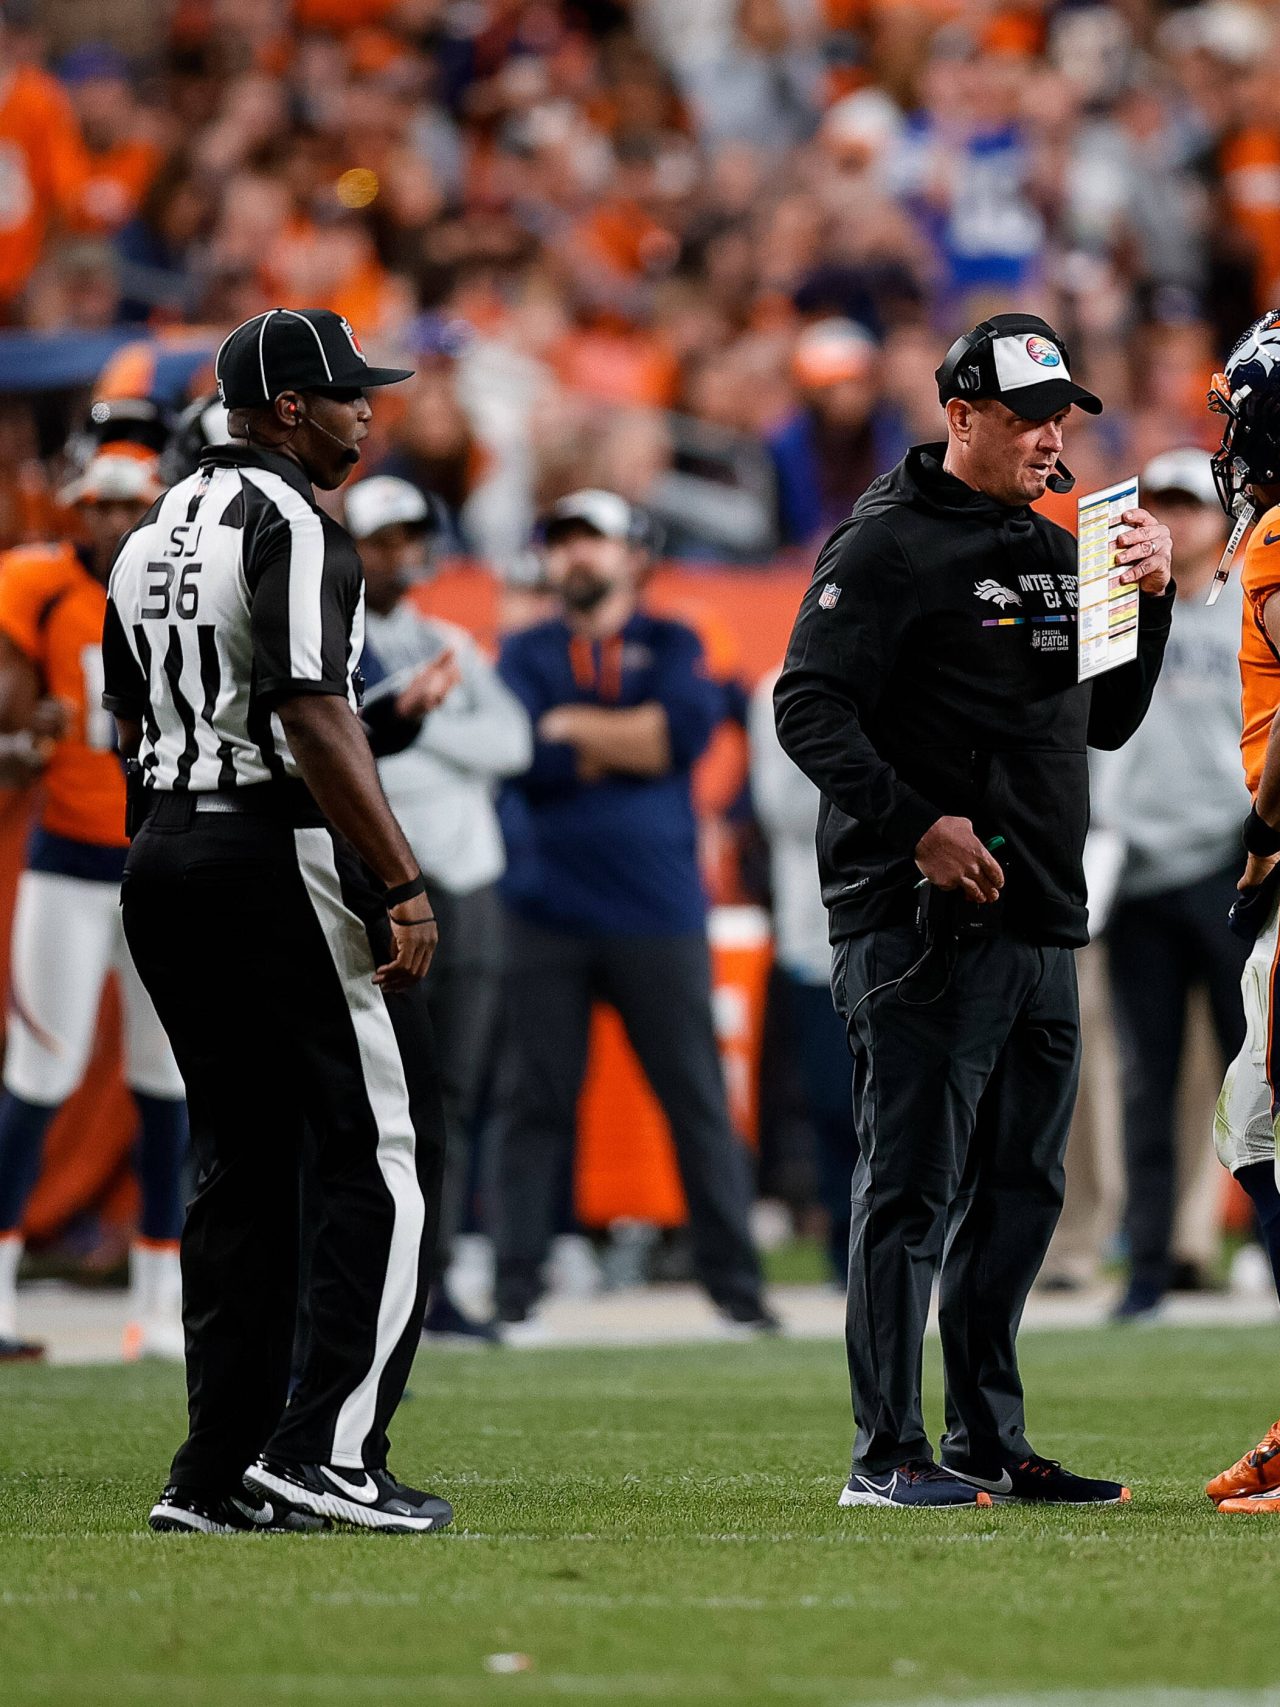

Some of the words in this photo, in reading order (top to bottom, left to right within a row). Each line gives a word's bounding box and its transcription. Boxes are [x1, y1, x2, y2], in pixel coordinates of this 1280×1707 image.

[163, 525, 203, 558] SJ
[141, 562, 203, 620] 36
[1041, 635, 1069, 647] CATCH
